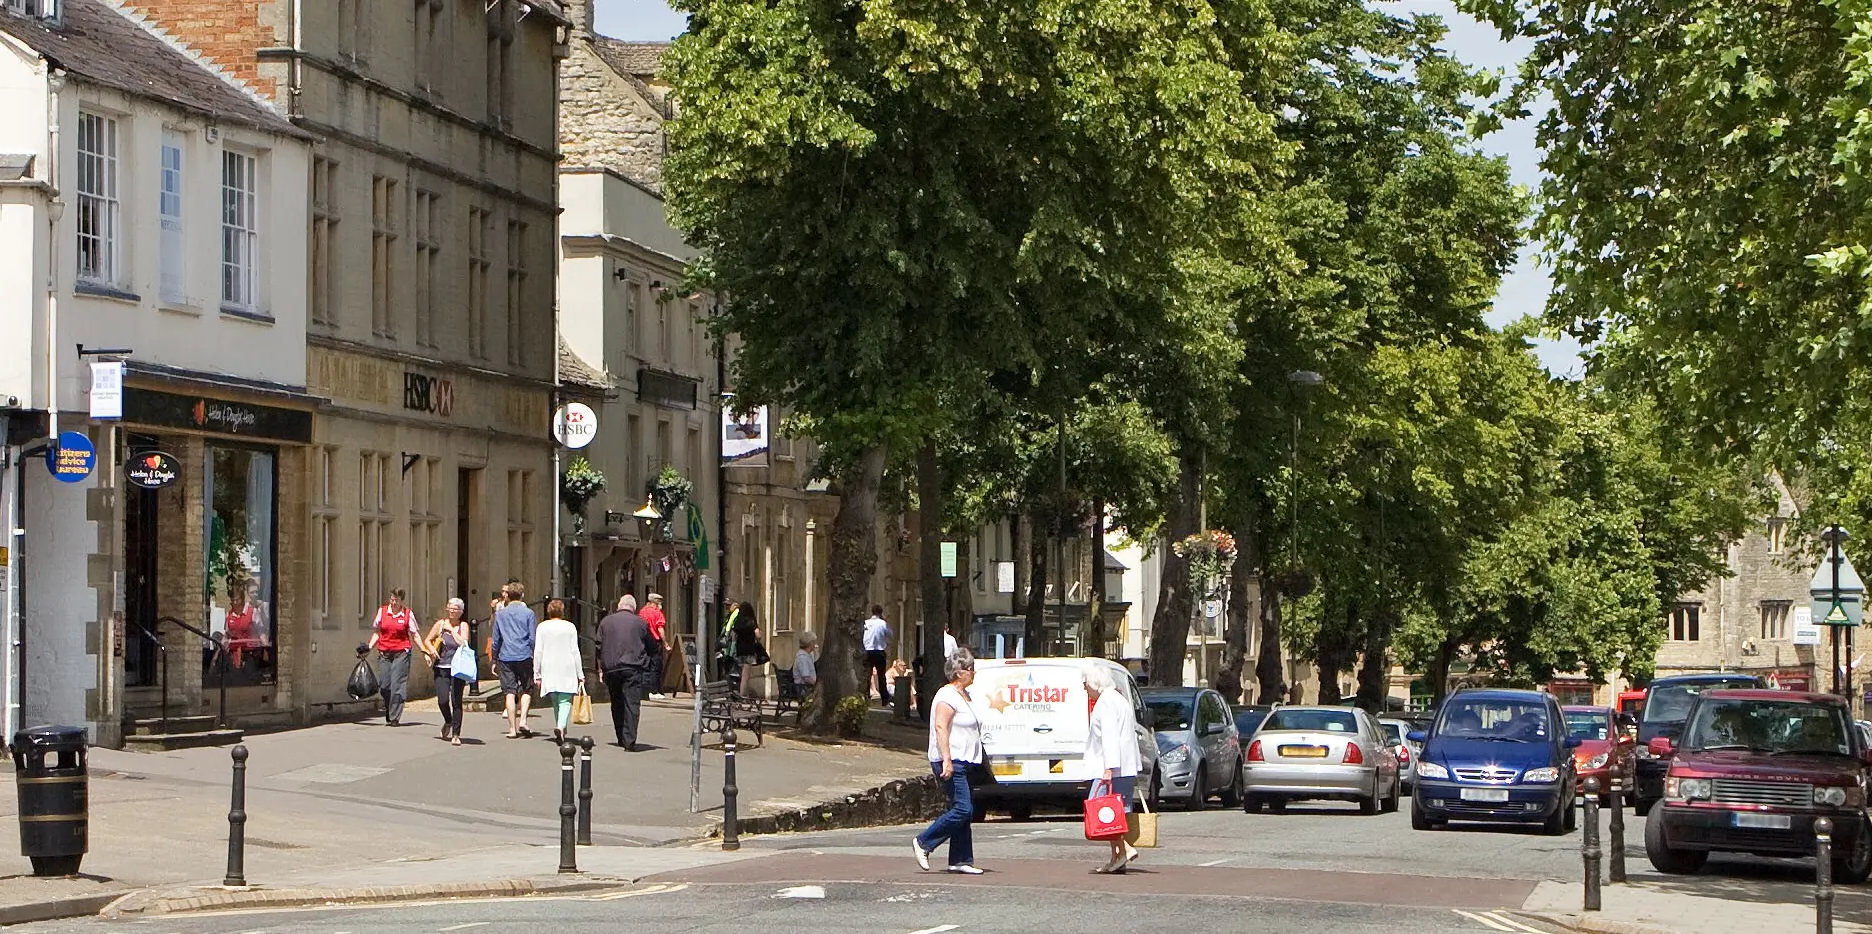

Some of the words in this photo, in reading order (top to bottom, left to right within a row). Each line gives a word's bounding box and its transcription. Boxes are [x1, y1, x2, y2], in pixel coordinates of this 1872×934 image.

[403, 371, 438, 414] HSBC
[557, 423, 593, 436] HSBC
[1007, 684, 1069, 703] Tristar
